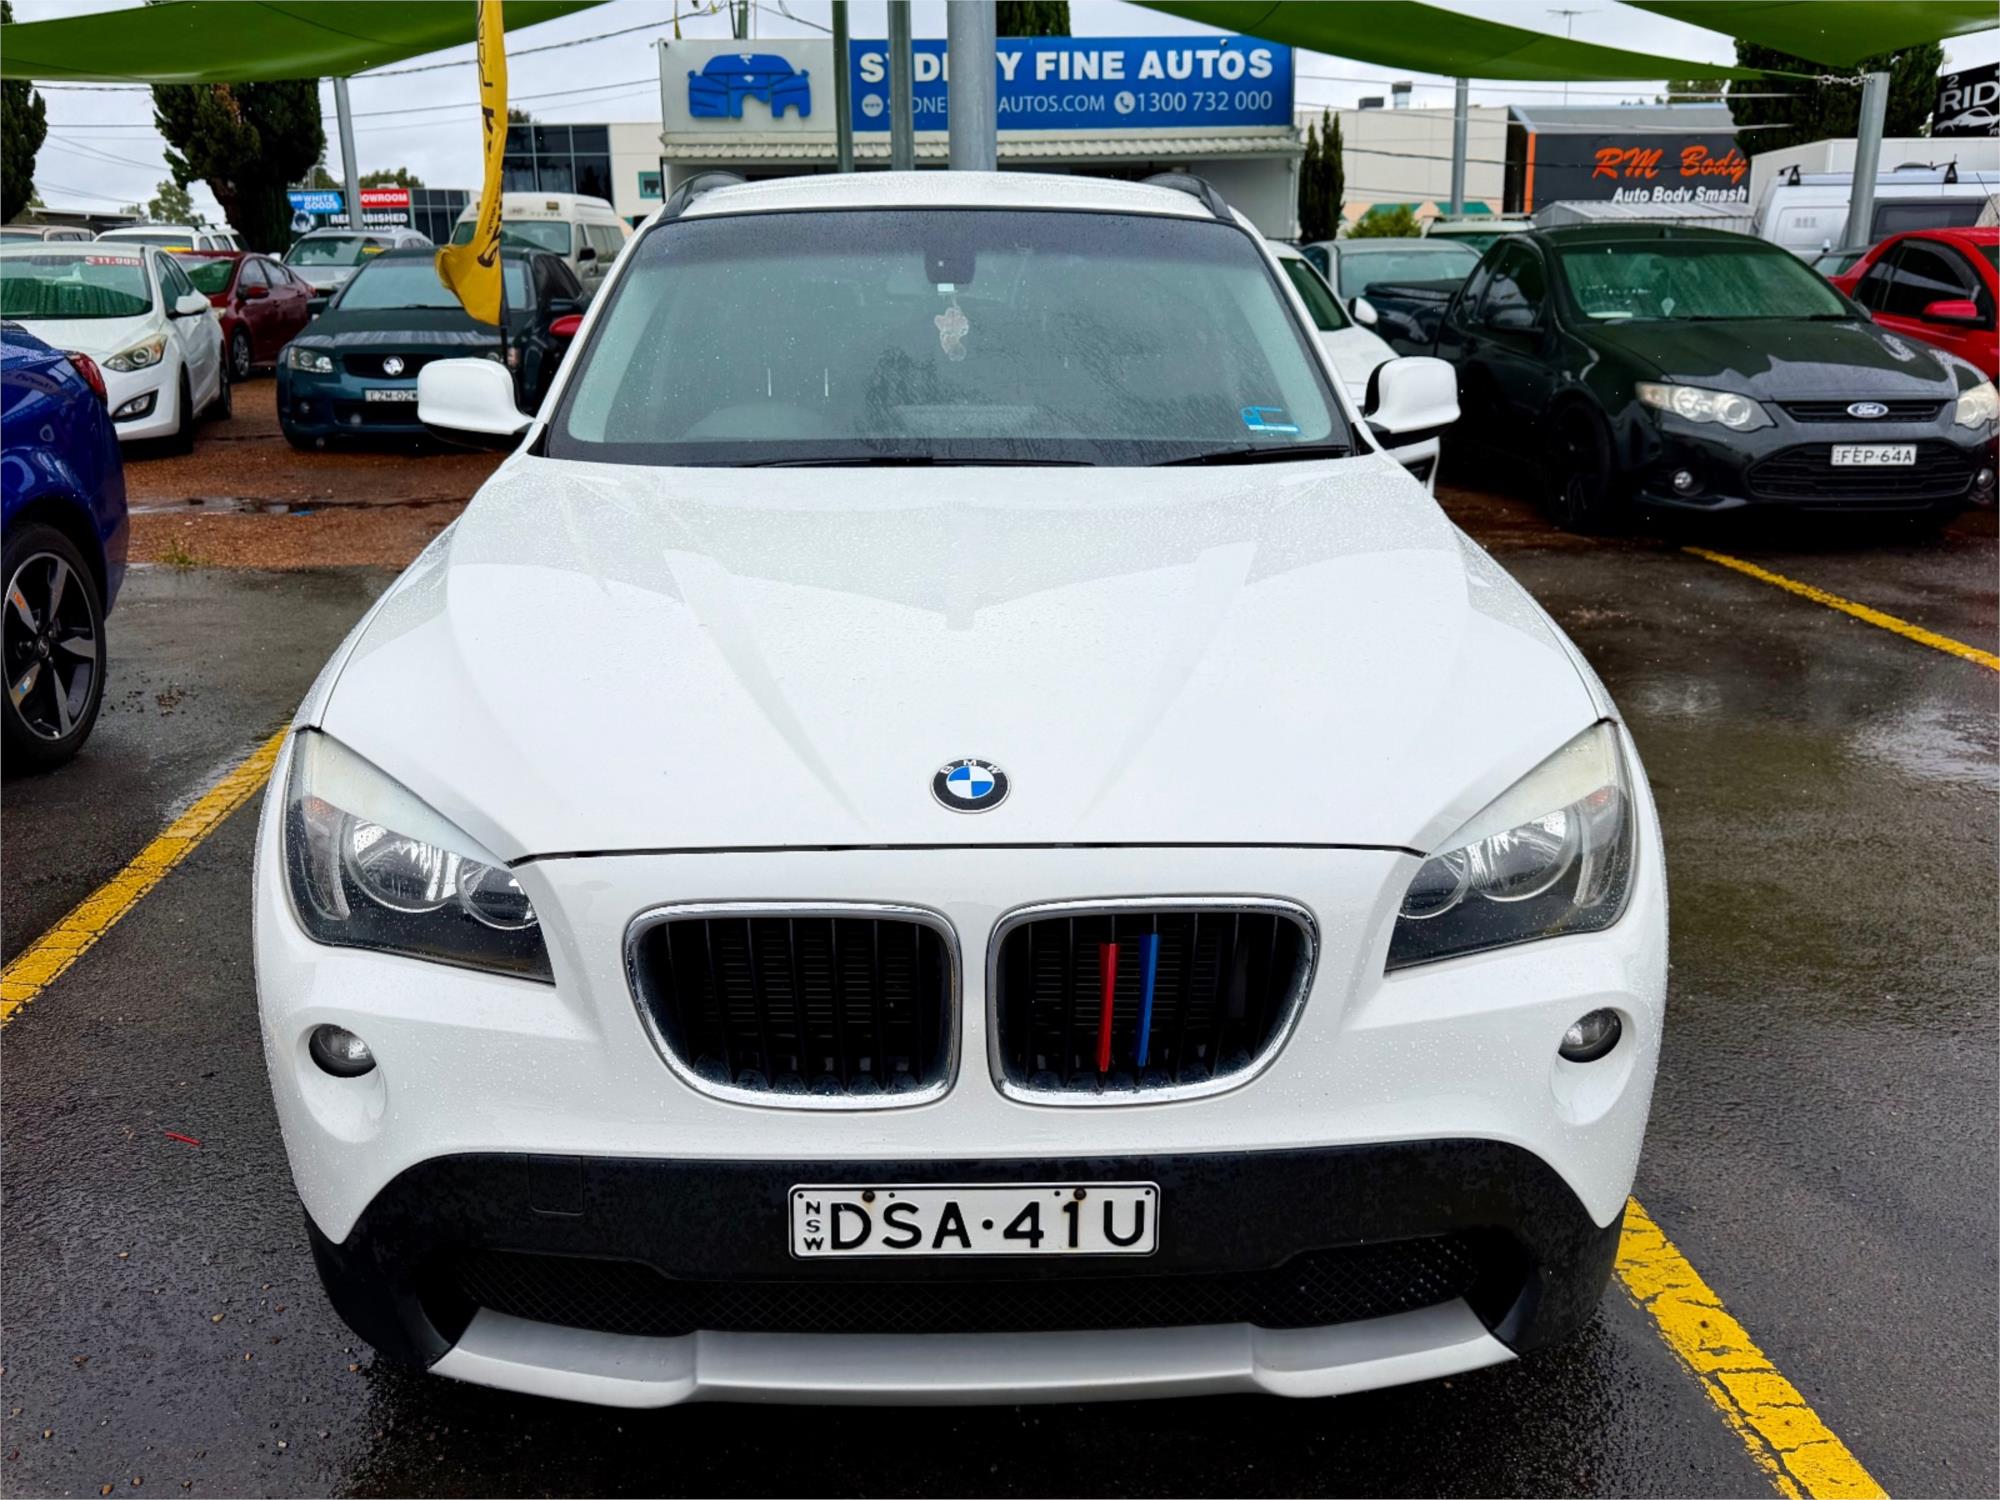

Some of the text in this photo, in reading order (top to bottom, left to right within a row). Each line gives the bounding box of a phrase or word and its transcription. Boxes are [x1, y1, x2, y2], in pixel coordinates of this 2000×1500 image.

[1036, 51, 1125, 81] FINE
[1138, 48, 1273, 80] AUTOS
[1947, 75, 1959, 88] 2
[1138, 90, 1273, 112] 1300 732 000
[1592, 145, 1747, 184] RM Body
[361, 194, 408, 203] OWROOM
[1613, 185, 1747, 203] Auto Body Smash
[304, 201, 338, 210] GOODS
[940, 759, 1001, 774] BMW
